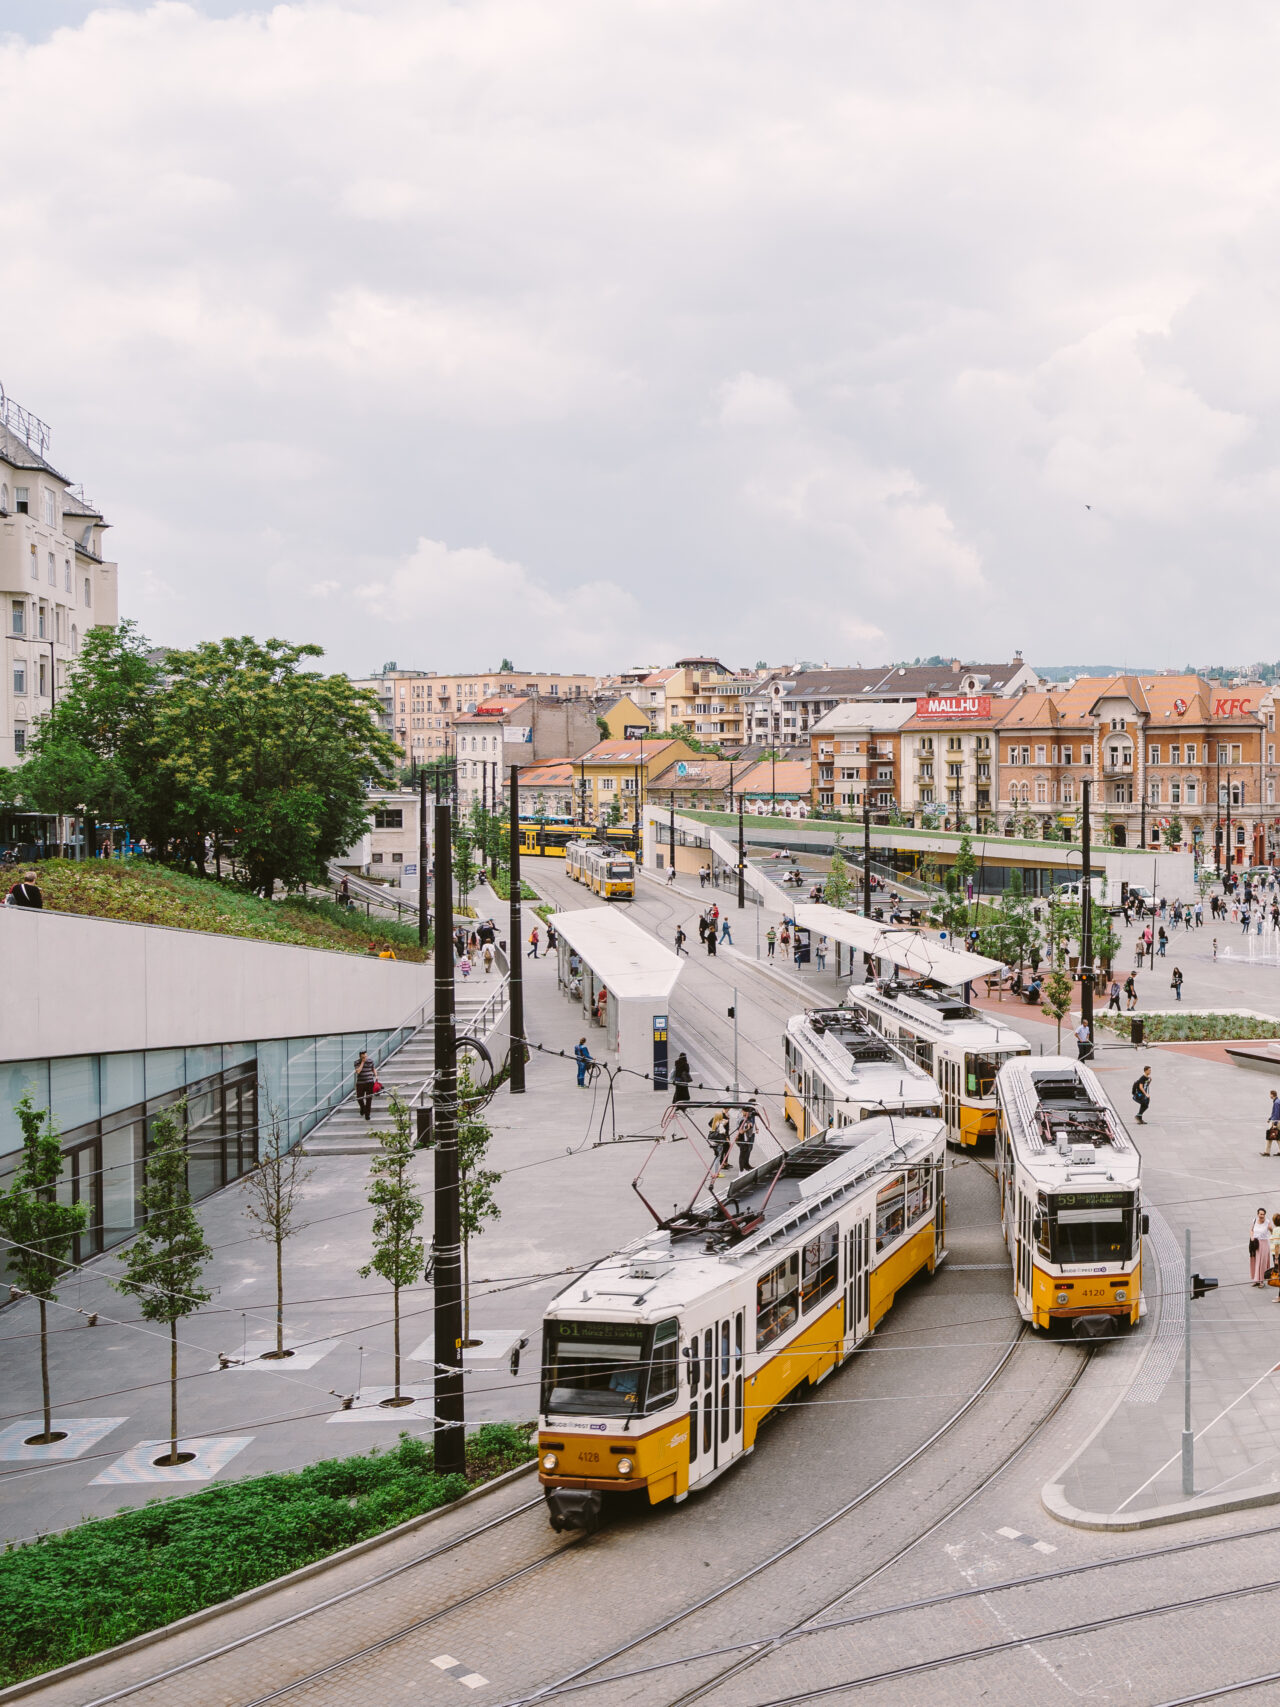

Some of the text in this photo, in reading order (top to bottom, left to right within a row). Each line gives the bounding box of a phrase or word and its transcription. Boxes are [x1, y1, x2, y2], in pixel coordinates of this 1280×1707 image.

[928, 699, 979, 712] MALL.HU
[1213, 699, 1251, 715] KFC
[1219, 818, 1237, 826] KC
[1058, 1194, 1075, 1206] 59
[1082, 1289, 1105, 1297] 4120
[559, 1321, 580, 1336] 61
[578, 1451, 600, 1463] 4128
